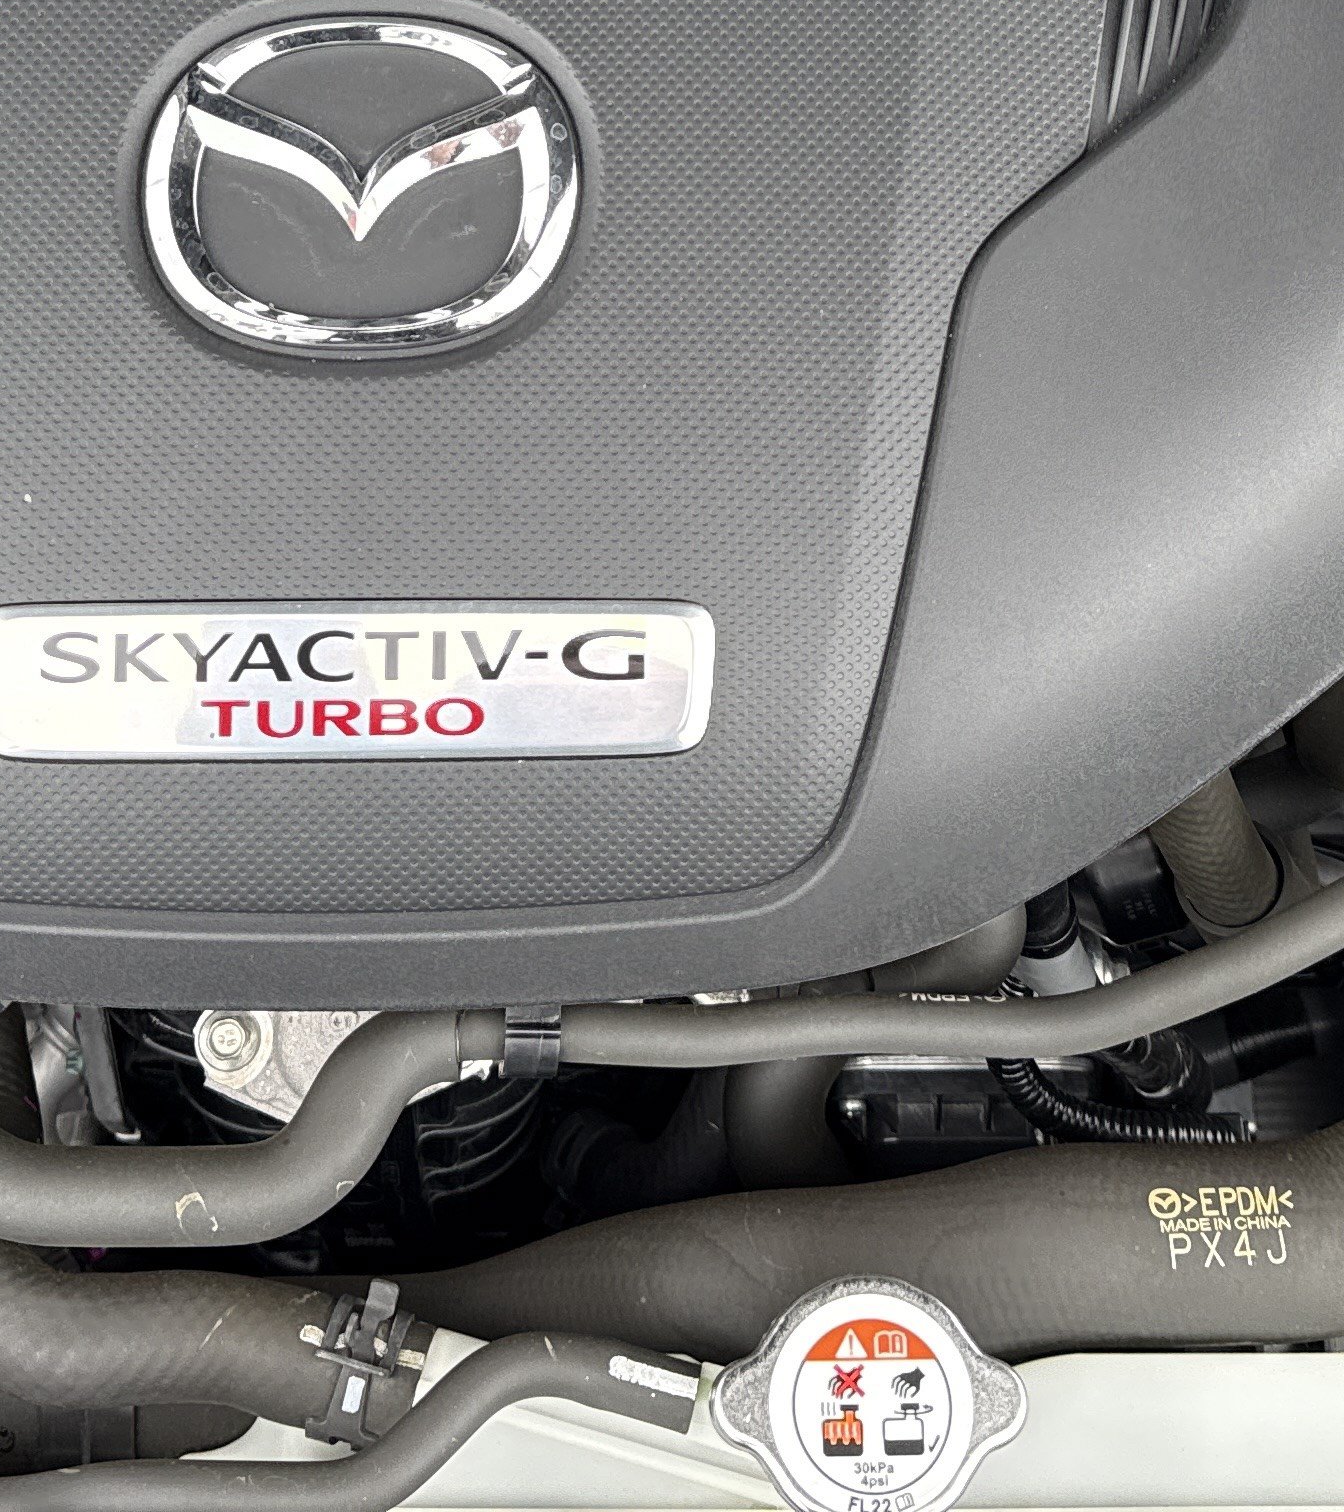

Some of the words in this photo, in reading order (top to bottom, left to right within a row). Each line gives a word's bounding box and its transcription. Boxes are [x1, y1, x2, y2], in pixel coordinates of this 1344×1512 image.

[39, 627, 647, 685] SKYACTIV-G
[200, 696, 486, 740] TURBO
[1159, 1217, 1213, 1234] MADE
[1213, 1216, 1232, 1232] IN
[1233, 1214, 1292, 1232] CHINA
[853, 1461, 895, 1475] 30kPa
[859, 1475, 890, 1490] 4psi
[847, 1495, 893, 1512] FL22
